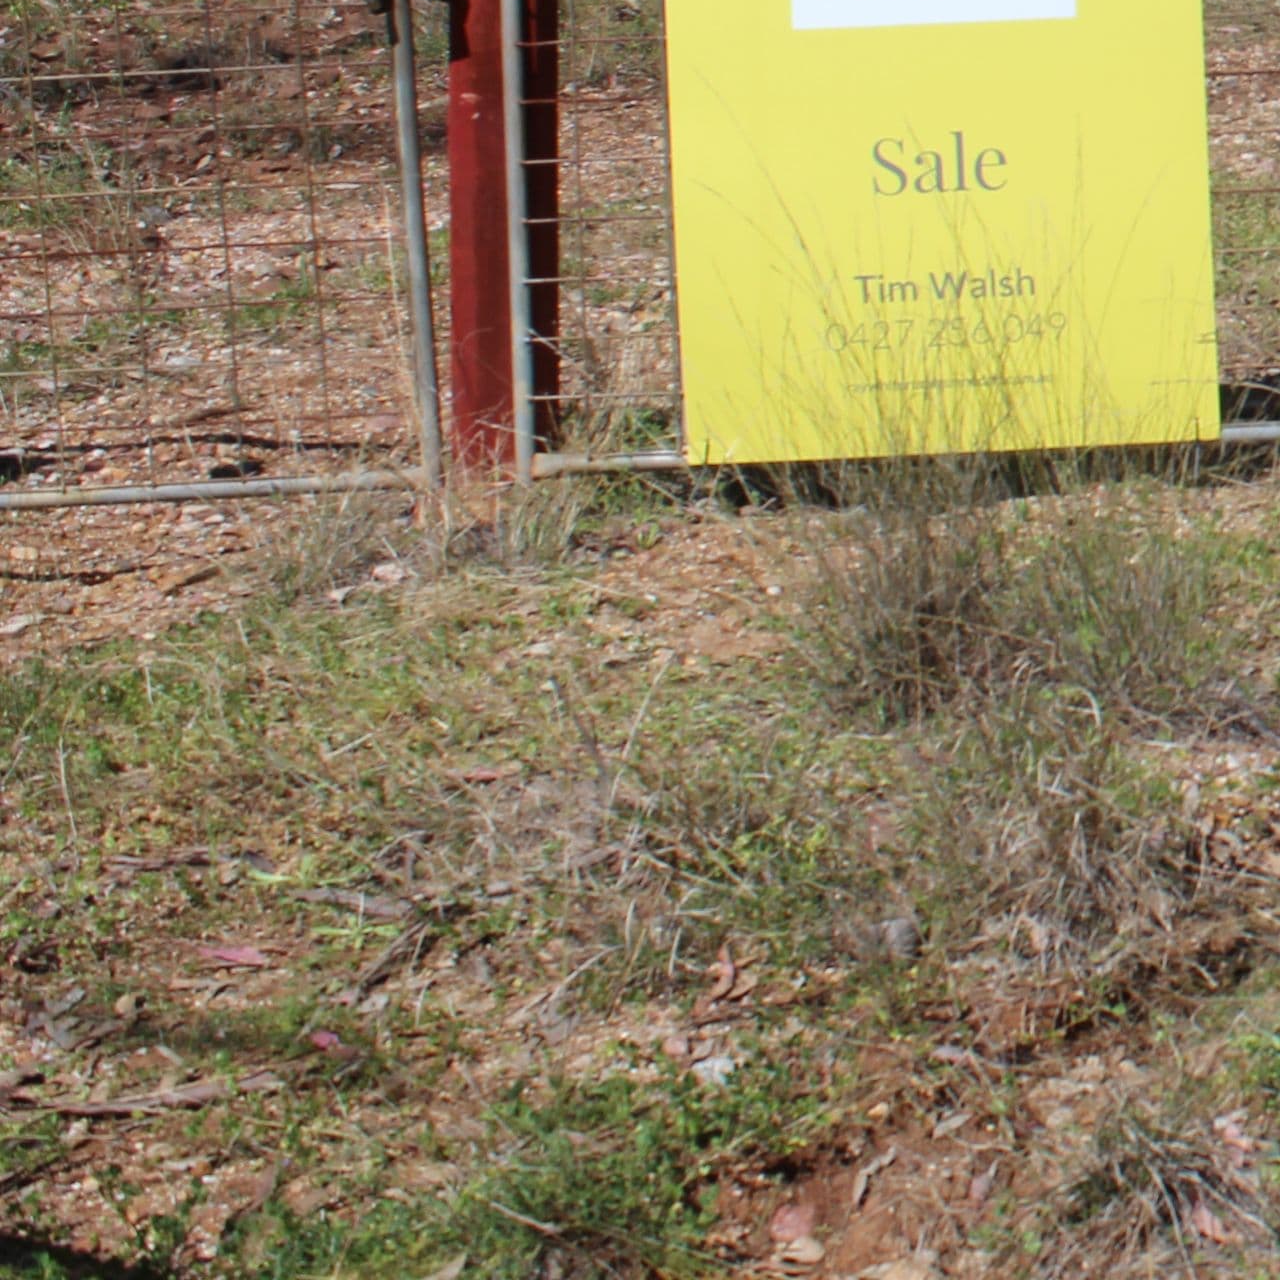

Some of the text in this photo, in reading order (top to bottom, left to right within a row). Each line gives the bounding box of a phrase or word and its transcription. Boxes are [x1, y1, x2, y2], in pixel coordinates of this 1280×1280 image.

[872, 130, 1008, 196] Sale
[853, 267, 1036, 304] Tim Walsh
[825, 319, 914, 352] 0427
[1003, 311, 1066, 344] 049
